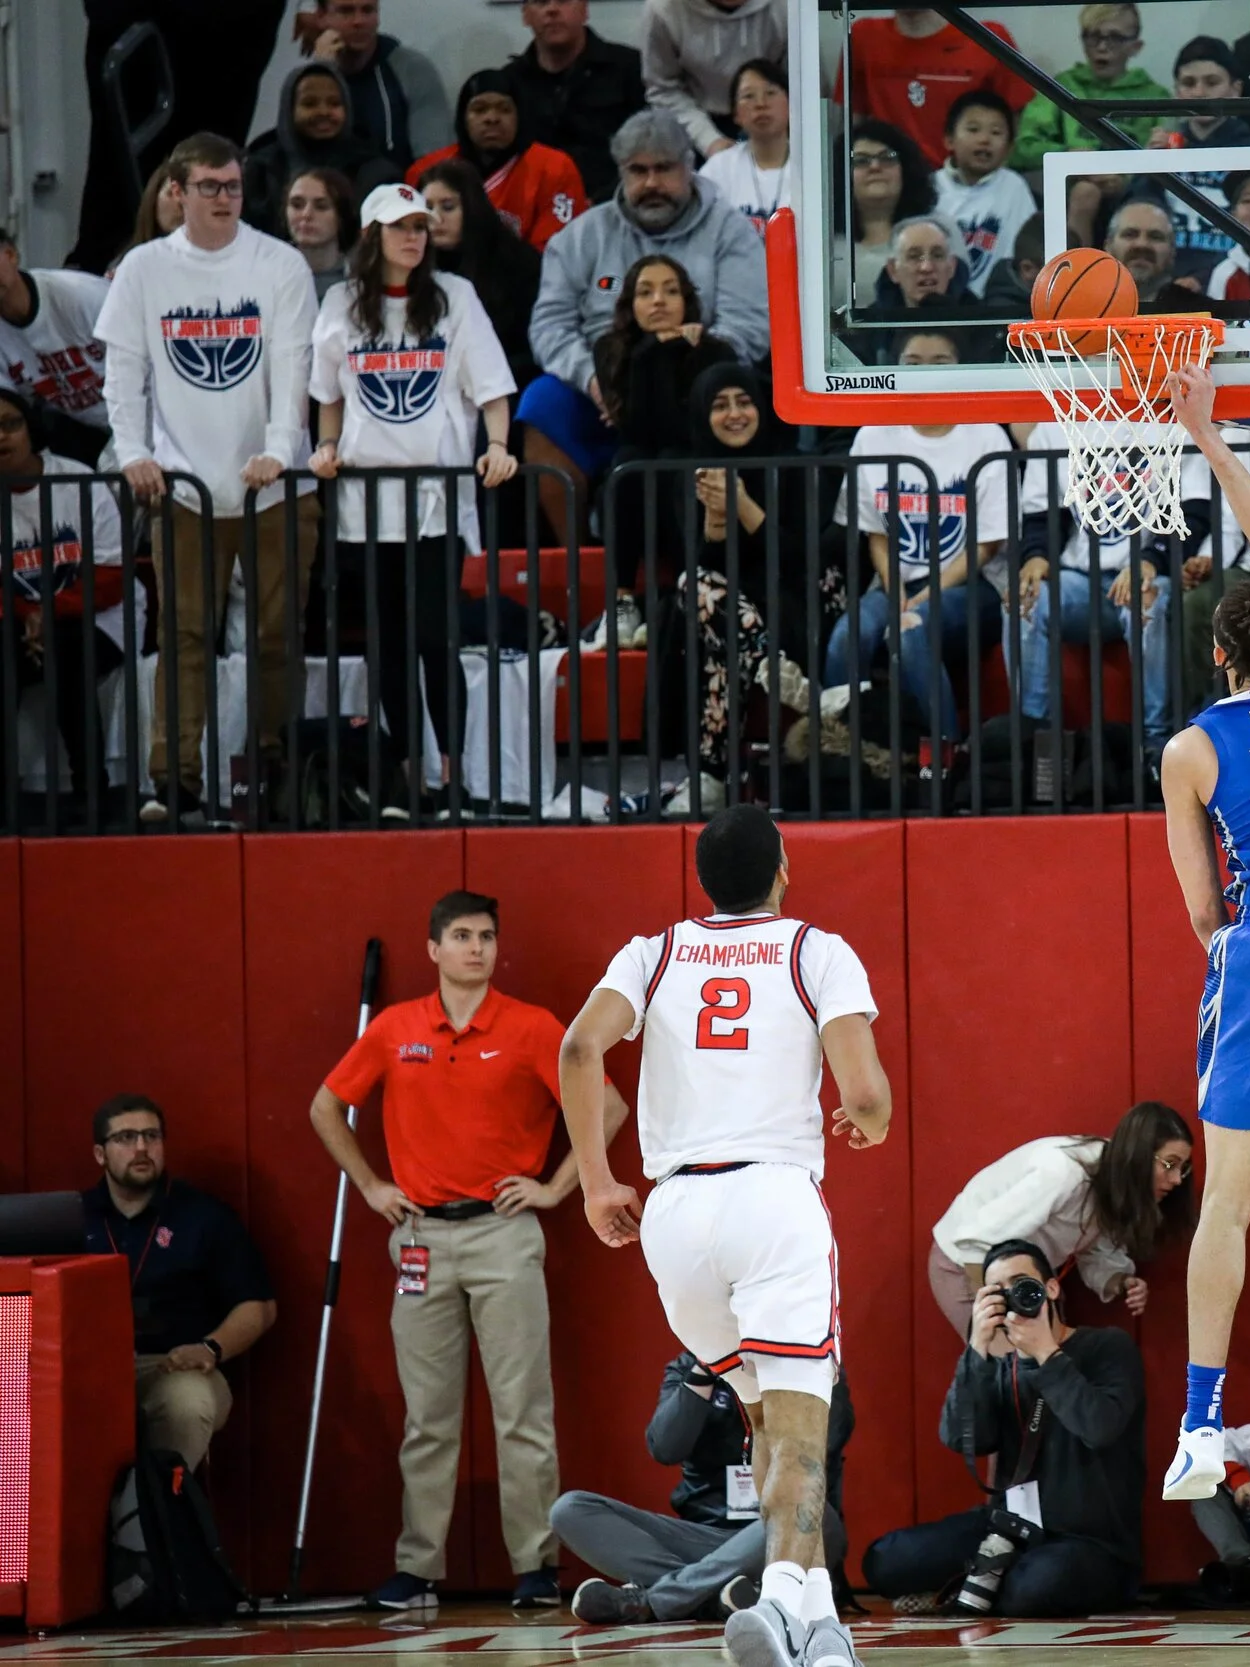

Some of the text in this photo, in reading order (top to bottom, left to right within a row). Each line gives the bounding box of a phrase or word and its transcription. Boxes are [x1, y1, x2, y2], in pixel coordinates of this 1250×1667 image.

[825, 373, 896, 393] SPALDING
[675, 941, 785, 968] CHAMPAGNIE
[695, 977, 752, 1051] 2
[1029, 1398, 1044, 1432] Canon
